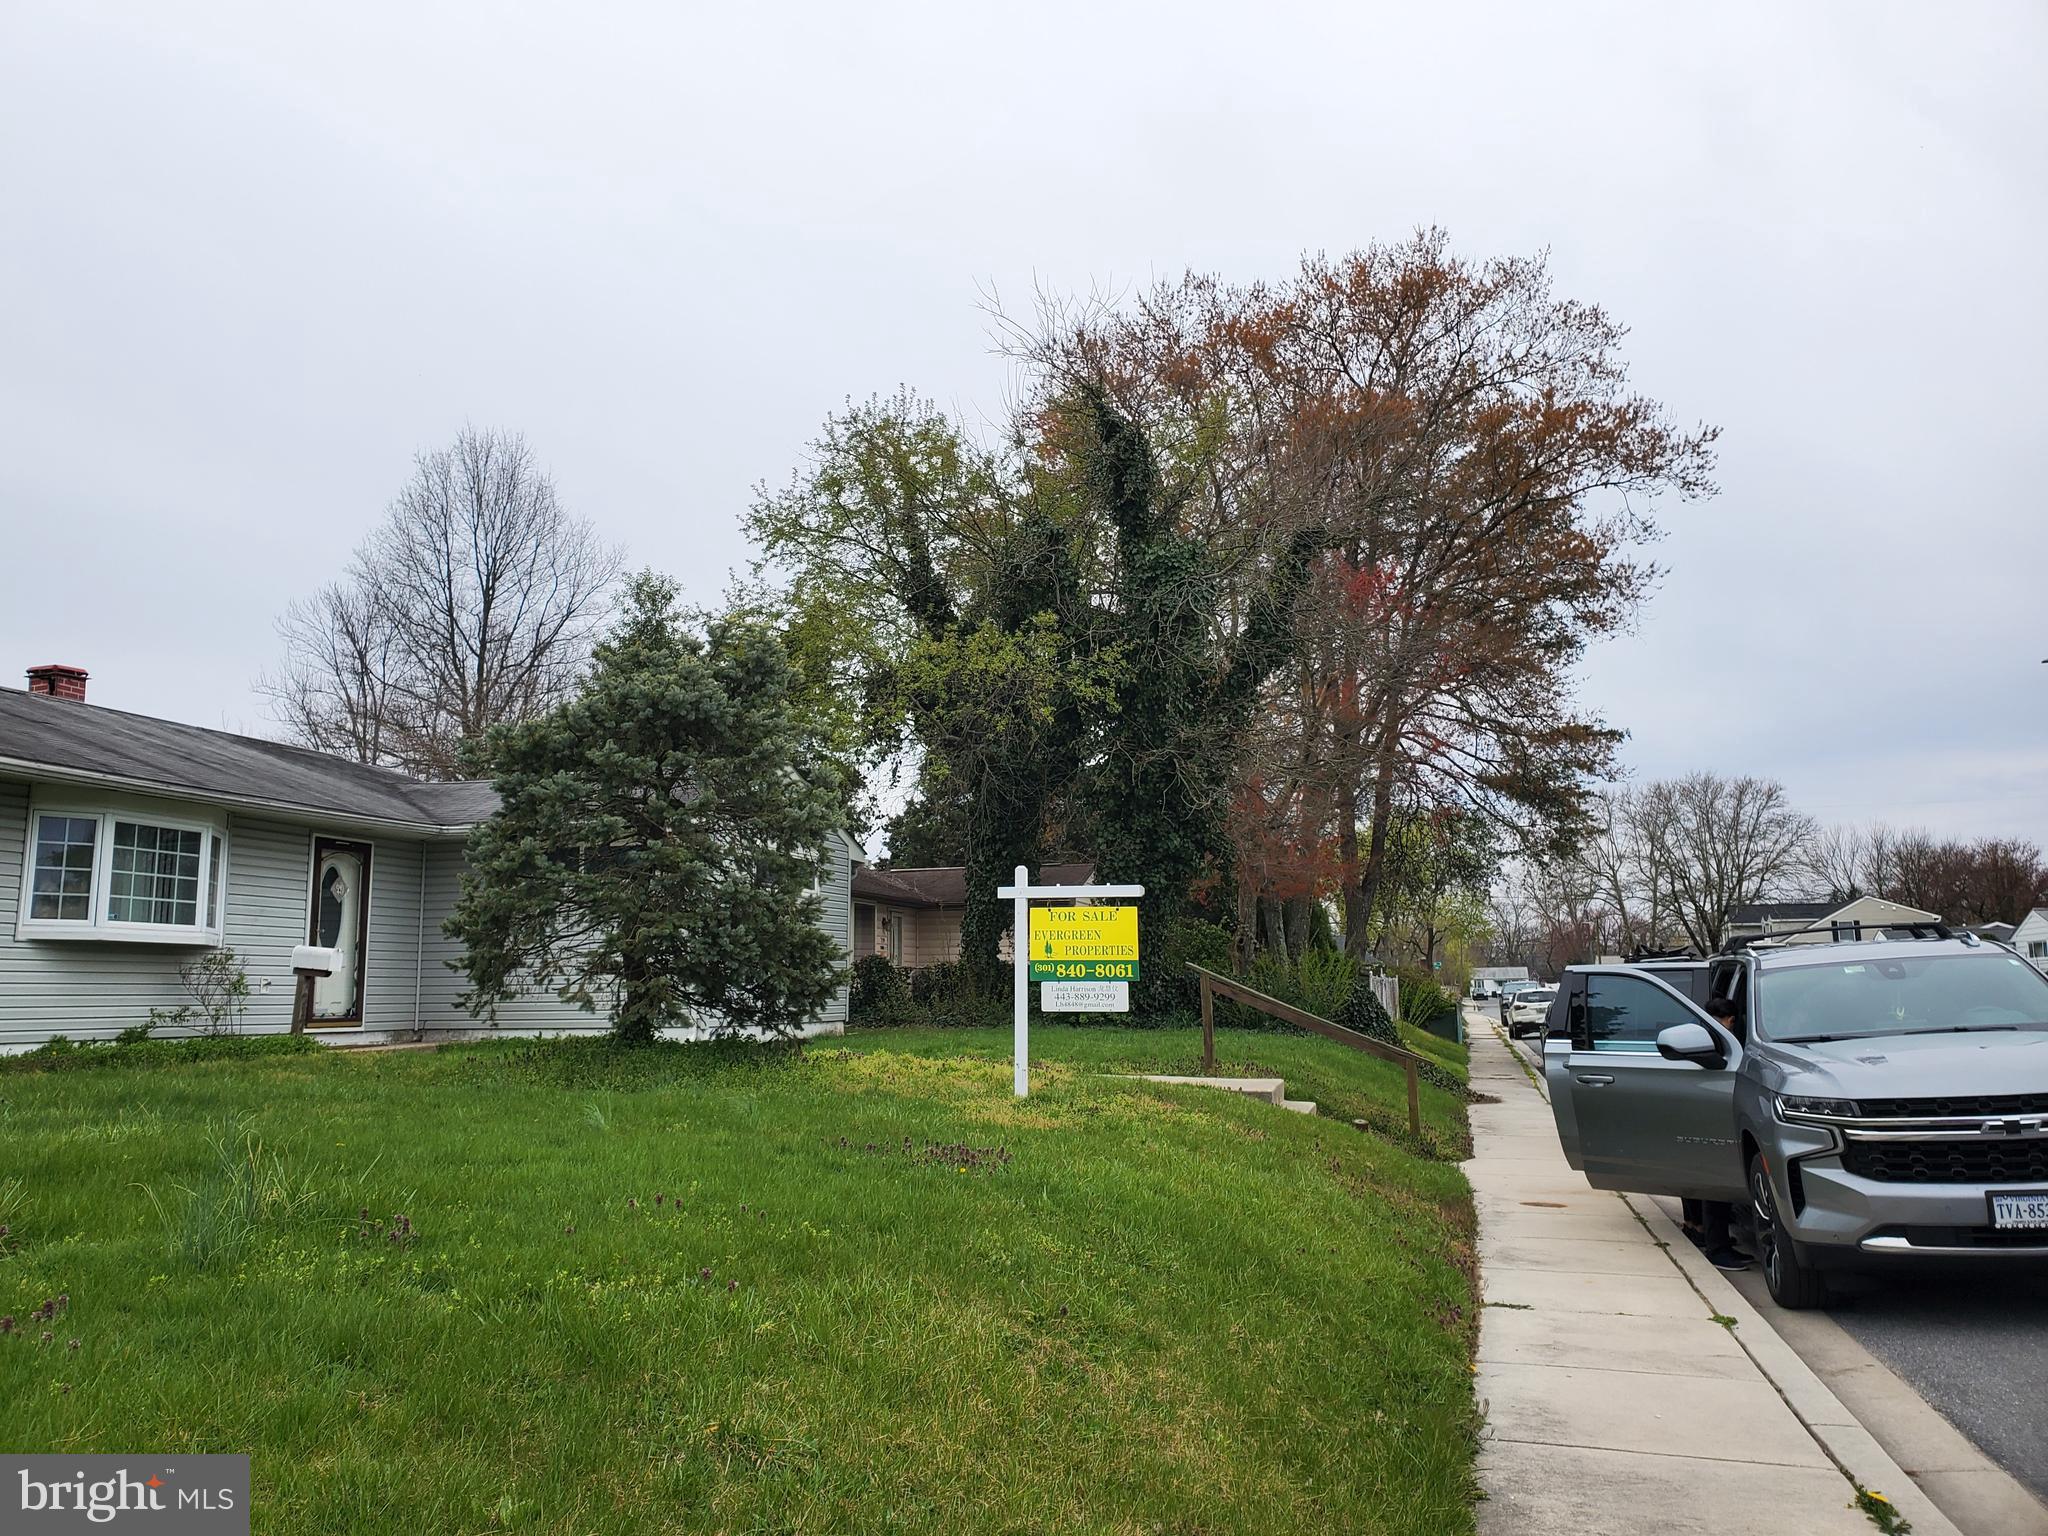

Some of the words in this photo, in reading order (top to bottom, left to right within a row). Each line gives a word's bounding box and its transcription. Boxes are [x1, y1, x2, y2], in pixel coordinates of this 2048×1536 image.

[1049, 911, 1076, 922] FOR
[1083, 911, 1118, 922] SALE
[1034, 930, 1101, 941] EVERGREEN
[1065, 945, 1134, 956] PROPERTIES
[1034, 963, 1055, 973] (301)
[1056, 963, 1134, 978] 840-8061
[1051, 985, 1069, 993] Linda
[1069, 985, 1097, 993] Harrison
[1054, 993, 1116, 1001] 443-889-9299
